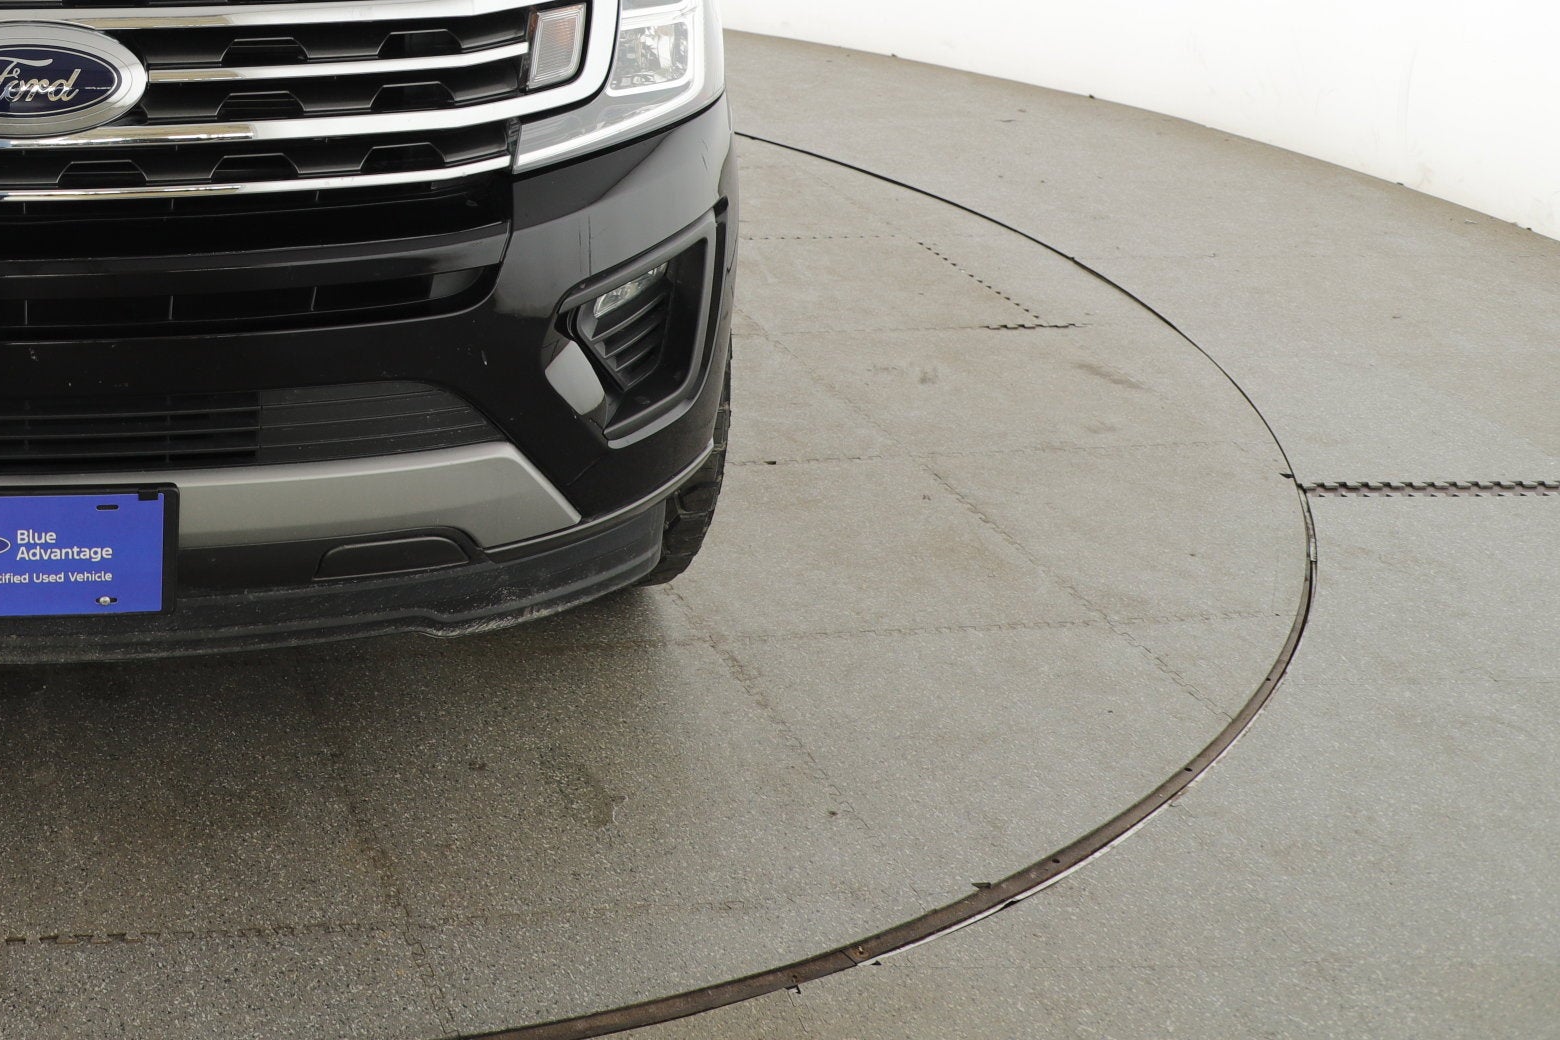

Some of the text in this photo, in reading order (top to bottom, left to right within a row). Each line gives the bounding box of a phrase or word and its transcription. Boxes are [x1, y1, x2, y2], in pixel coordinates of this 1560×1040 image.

[17, 529, 57, 545] Blue
[16, 545, 113, 562] Advantage
[33, 571, 65, 583] Used
[68, 570, 113, 582] Vehicle
